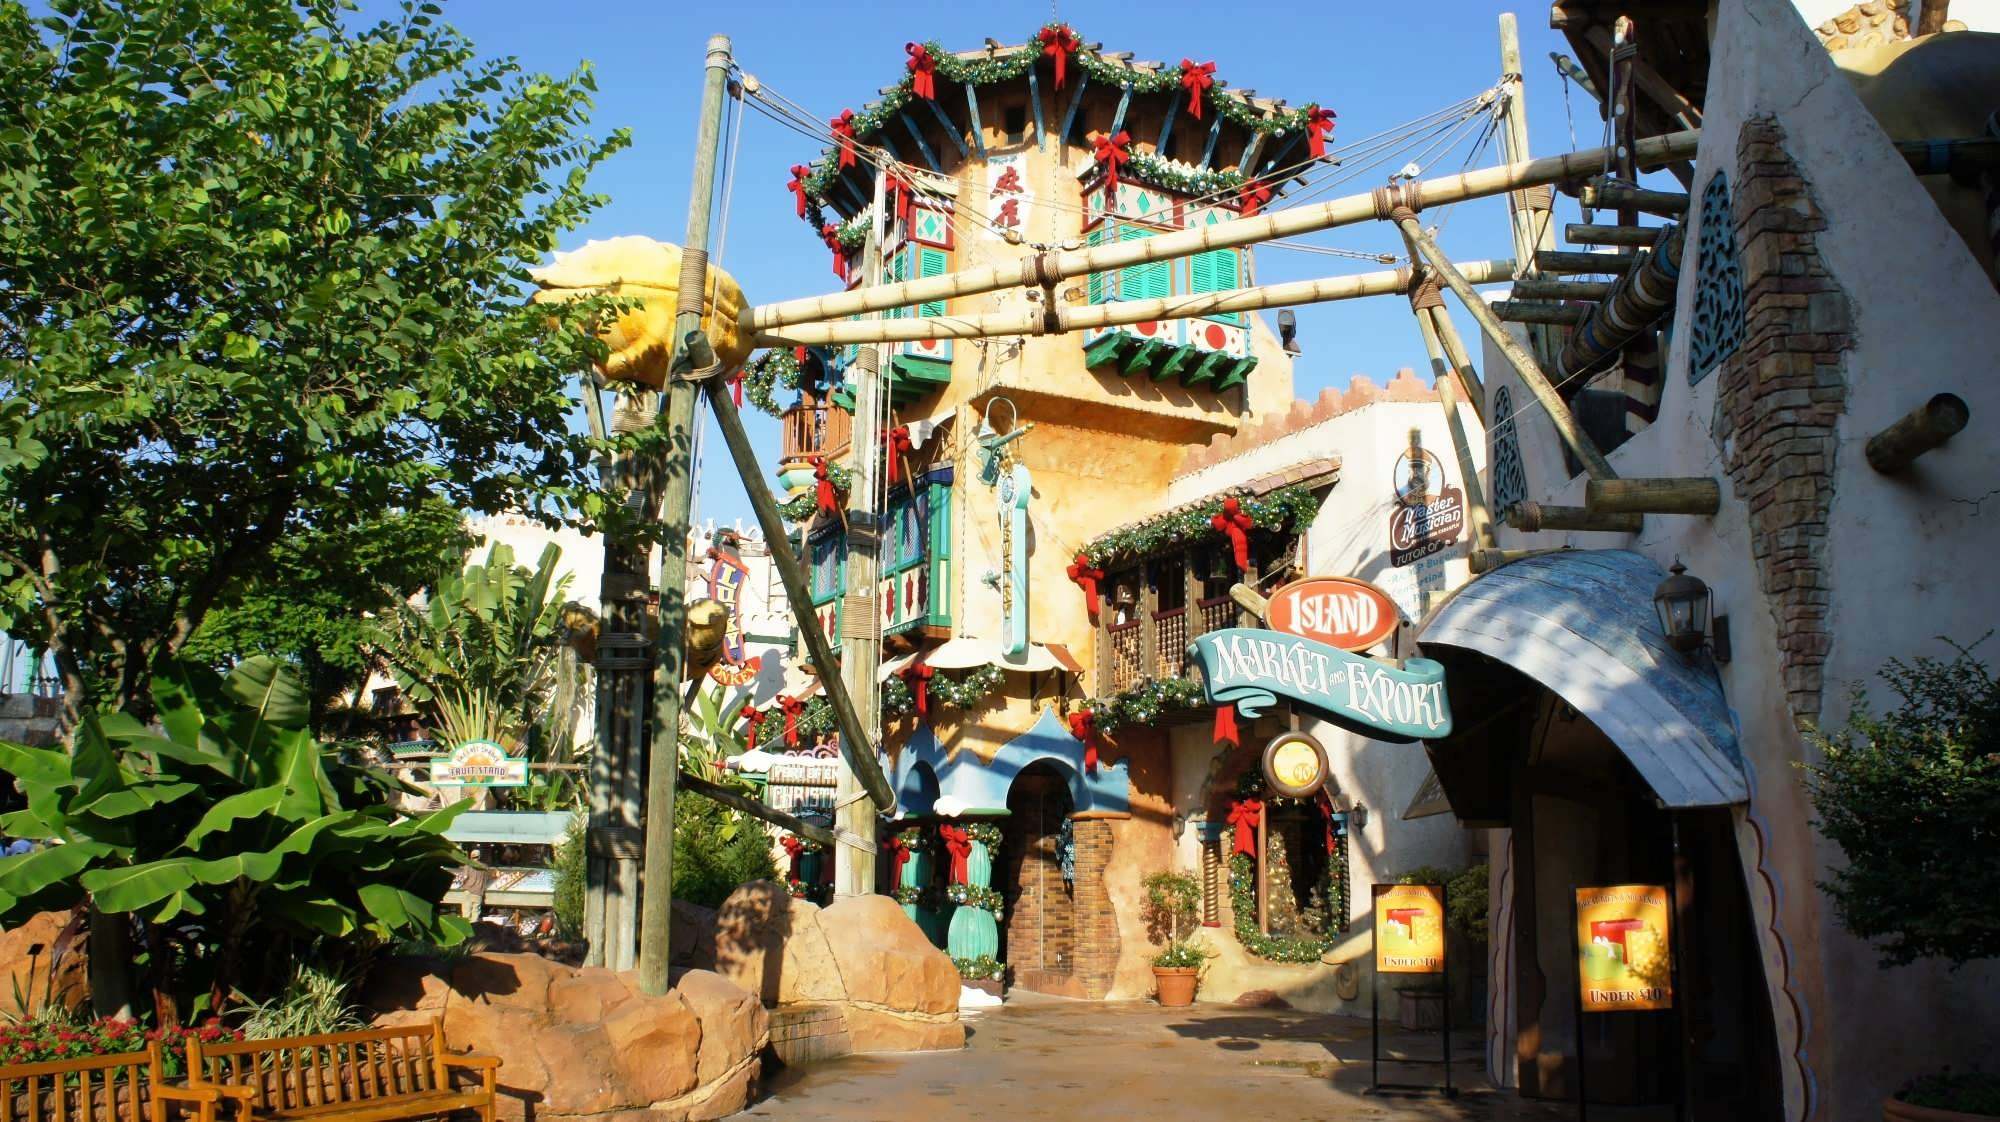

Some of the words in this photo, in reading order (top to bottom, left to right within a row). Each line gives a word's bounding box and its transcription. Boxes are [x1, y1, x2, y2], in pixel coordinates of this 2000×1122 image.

[1405, 497, 1454, 524] Master
[1401, 510, 1461, 543] Musician
[1397, 547, 1426, 566] TUTOR
[1288, 590, 1379, 636] ISLAND
[713, 663, 757, 684] ONKEY
[1211, 634, 1331, 696] MARKET
[1329, 670, 1346, 685] AND
[1343, 660, 1446, 730] EXPORT
[450, 766, 474, 776] FRUIT
[479, 766, 505, 776] STAND
[773, 785, 837, 809] CHRISTM
[1384, 957, 1417, 967] UNDER
[1590, 990, 1635, 1002] UNDER
